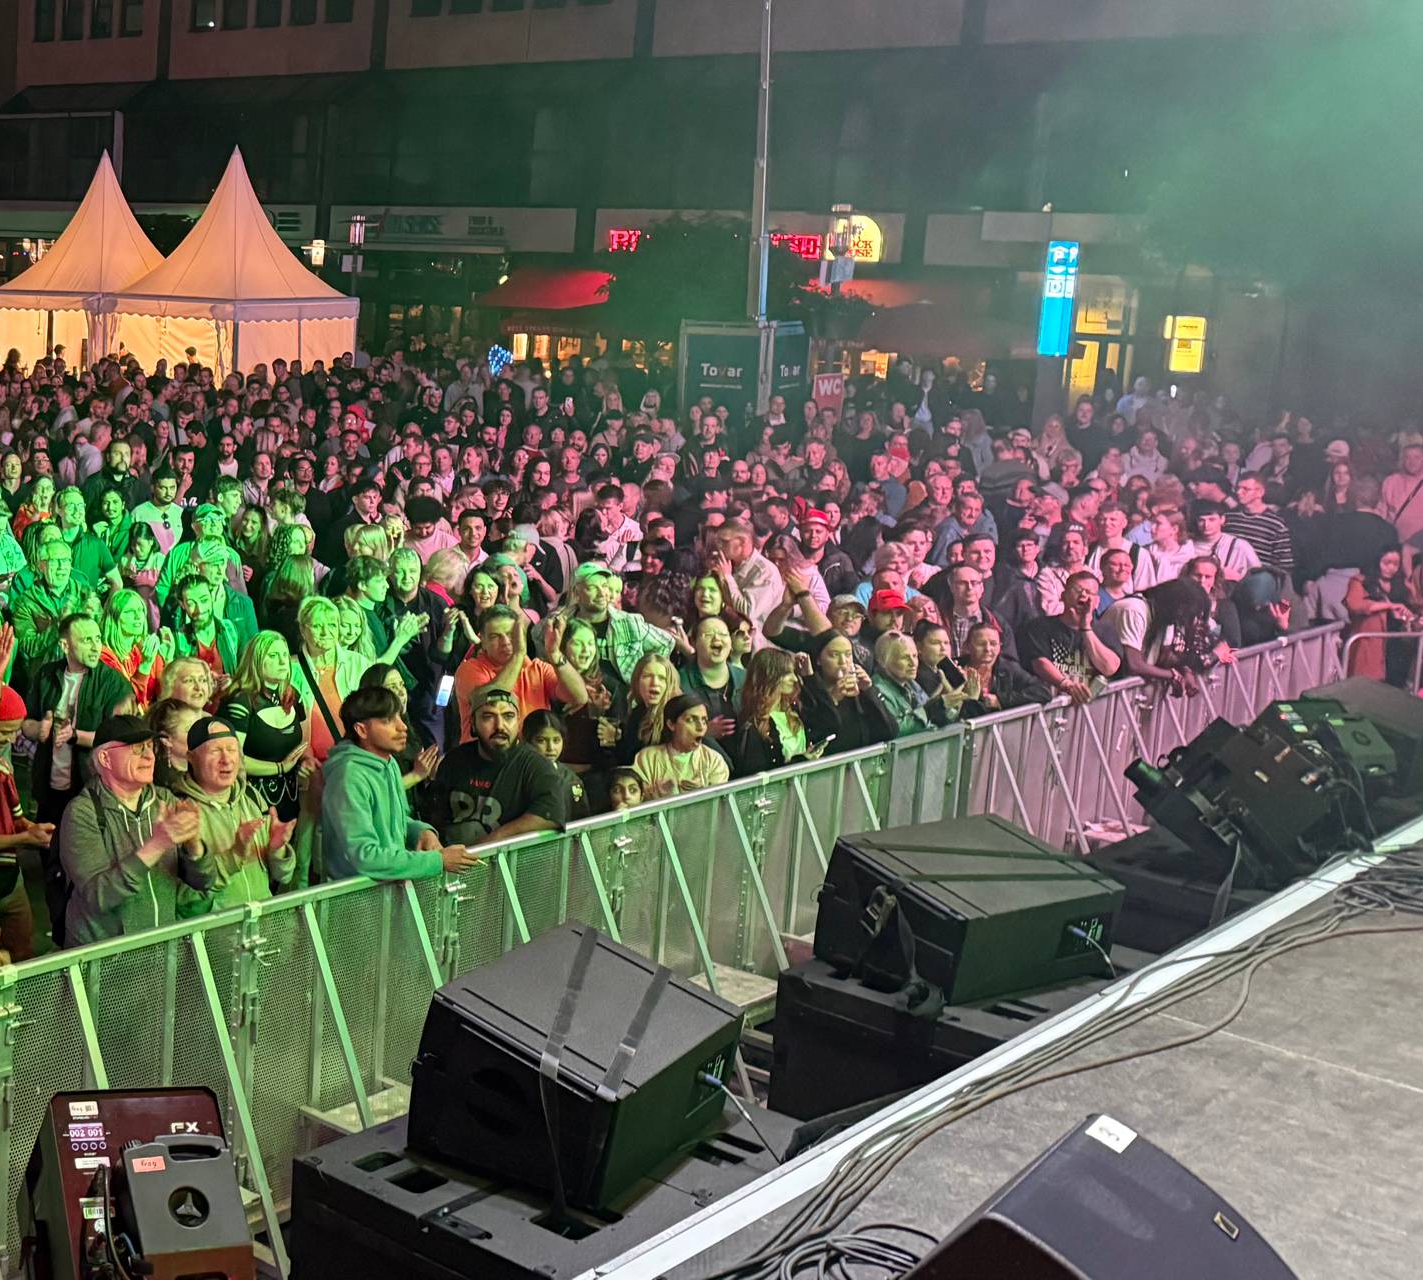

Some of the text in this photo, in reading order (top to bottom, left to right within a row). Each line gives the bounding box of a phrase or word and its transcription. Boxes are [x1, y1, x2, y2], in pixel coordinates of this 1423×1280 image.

[780, 364, 801, 377] Toar
[818, 379, 842, 397] WC
[171, 1121, 200, 1133] FX
